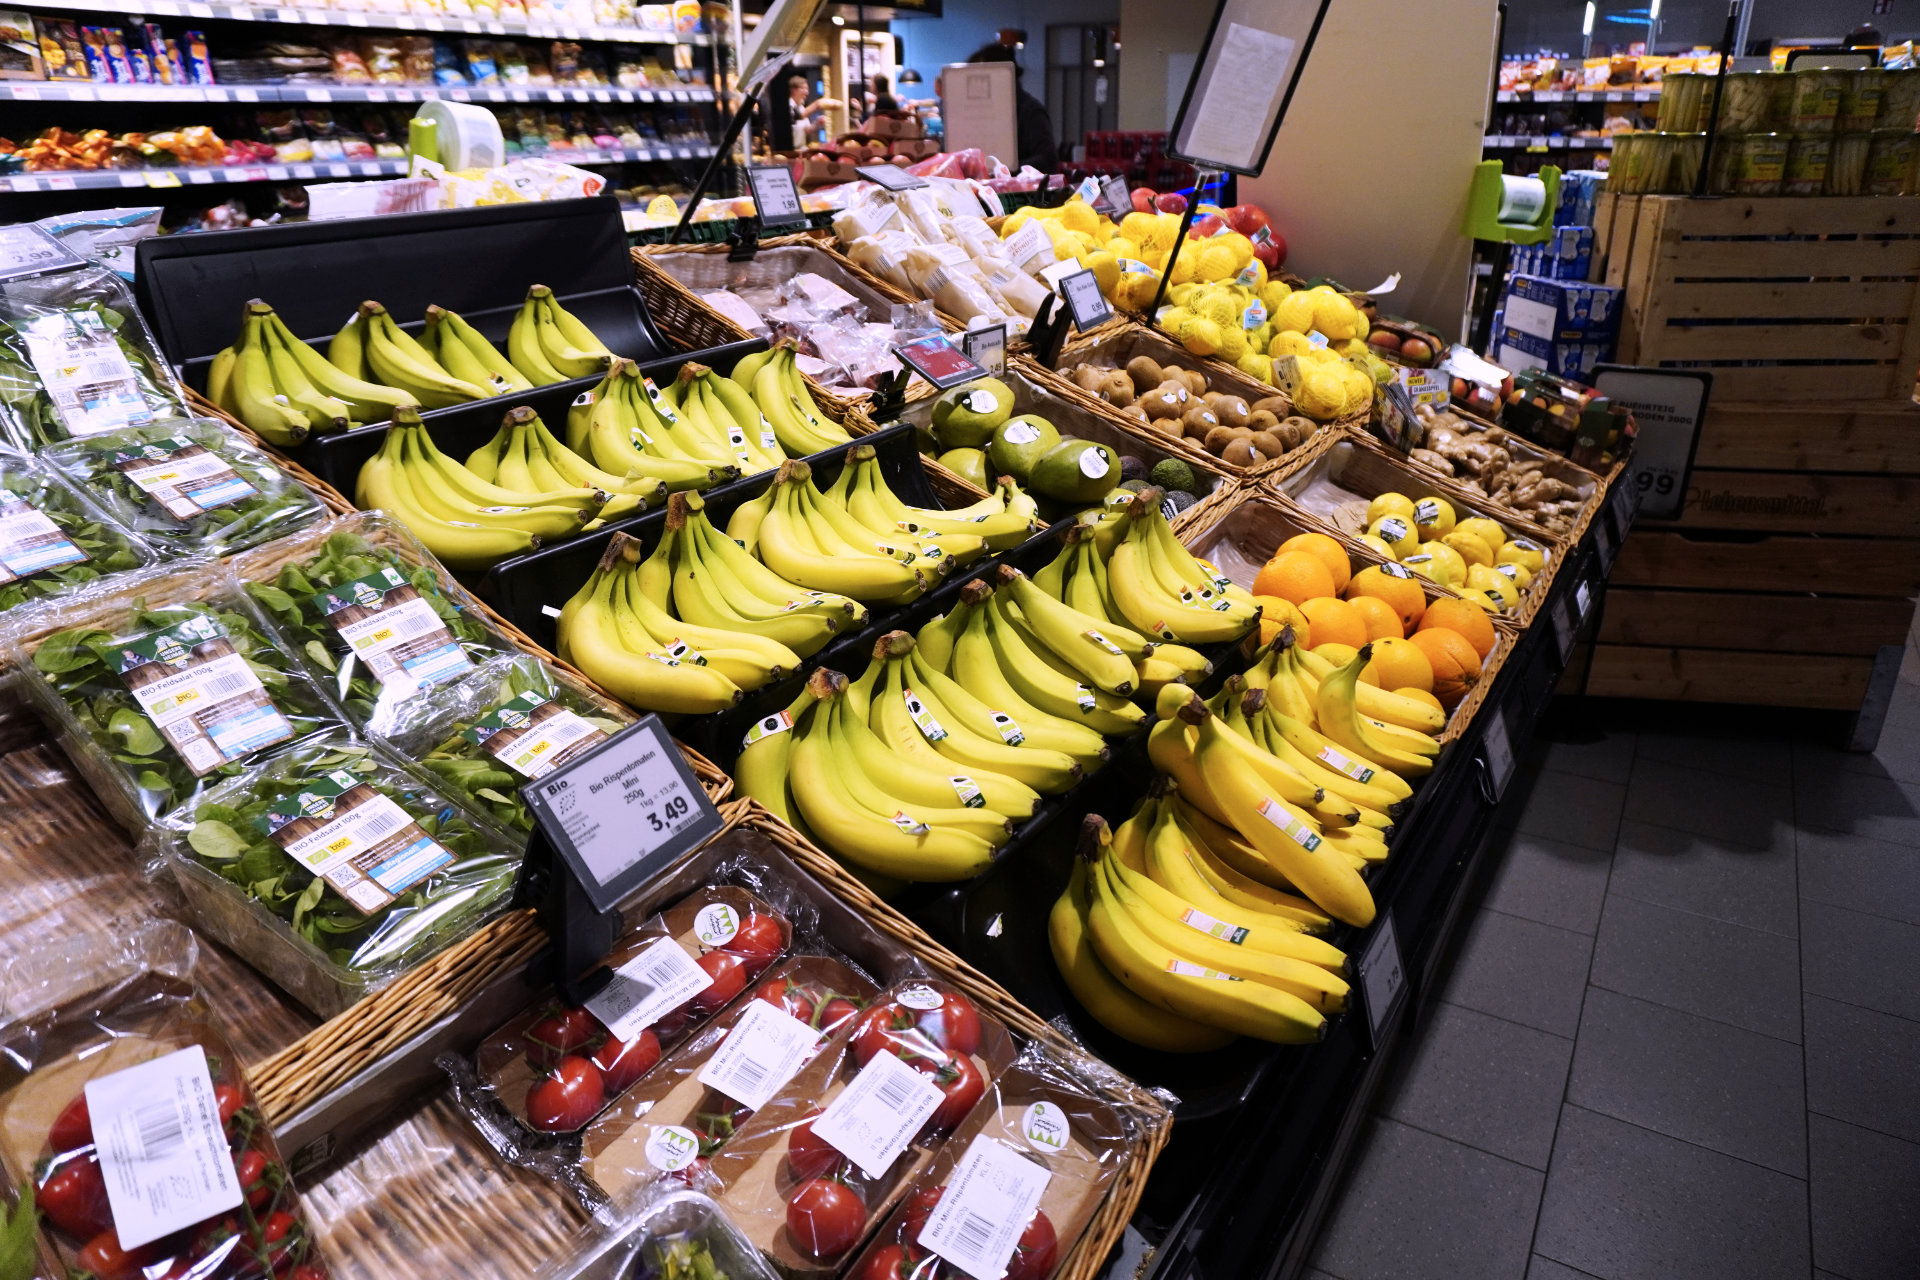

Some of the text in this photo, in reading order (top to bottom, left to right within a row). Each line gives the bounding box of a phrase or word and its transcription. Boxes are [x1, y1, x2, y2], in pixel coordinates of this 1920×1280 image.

[344, 613, 387, 635] BIO-Feldsalat
[139, 664, 213, 697] BIO-Feldsalat 100g
[588, 749, 657, 794] Bio Rispentomaten
[621, 774, 640, 790] Mini
[546, 777, 569, 796] Bio
[622, 786, 645, 805] 250g
[639, 796, 654, 810] 1kg
[658, 780, 679, 797] 13,96
[645, 794, 692, 833] 3,49
[292, 820, 343, 853] BIO-Feldsalat
[341, 810, 361, 826] 100g
[930, 1222, 944, 1238] BIO
